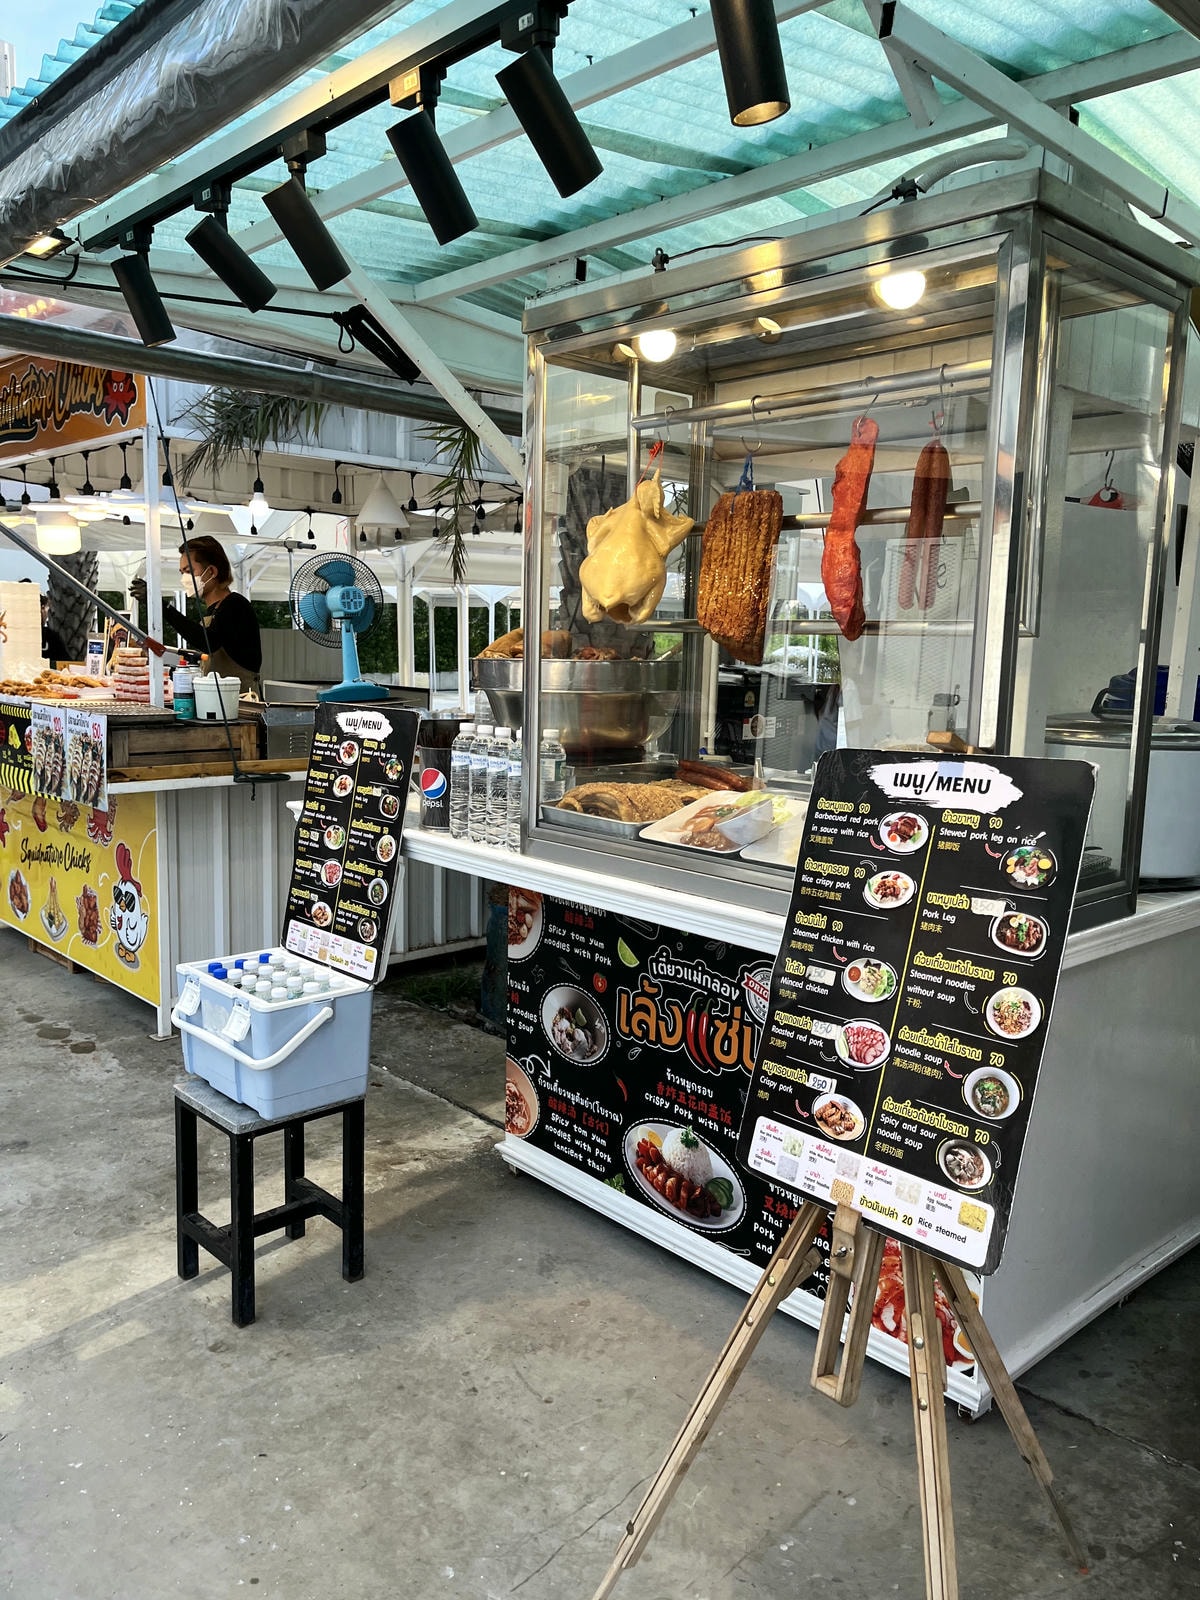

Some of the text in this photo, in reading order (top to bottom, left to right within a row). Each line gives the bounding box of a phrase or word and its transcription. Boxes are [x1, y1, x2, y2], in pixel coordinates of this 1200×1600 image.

[422, 799, 444, 808] pepsi
[859, 804, 870, 814] 90
[850, 816, 861, 824] red
[863, 818, 879, 826] pork
[989, 816, 1003, 829] 90
[820, 825, 838, 834] sauce
[840, 828, 855, 836] with
[857, 830, 870, 838] rice
[940, 828, 1037, 846] Stewed pork leg on rice
[20, 837, 91, 874] Squidnature Chicks
[801, 874, 851, 890] Rice crispy pork
[854, 868, 866, 878] 90
[922, 908, 956, 924] Pork Leg
[832, 920, 844, 932] 90
[544, 938, 570, 952] noodles
[574, 947, 592, 960] with
[570, 932, 586, 943] tom
[589, 938, 605, 950] yum
[792, 928, 876, 953] Steamed chicken with rice
[780, 976, 829, 996] Minced chicken
[910, 969, 976, 992] Steamed noodles
[1002, 971, 1018, 986] 70
[907, 984, 956, 1004] without soup
[512, 1008, 538, 1023] noodles
[772, 1025, 824, 1048] Roasted red pork
[894, 1044, 943, 1066] Noodle soup
[990, 1052, 1004, 1067] 70
[665, 1068, 714, 1098] ข้าวหมูกรอบ
[760, 1076, 793, 1094] Crispy pork
[573, 1123, 588, 1138] tom
[591, 1132, 607, 1148] yum
[698, 1116, 719, 1132] with
[724, 1126, 740, 1141] rice
[880, 1114, 938, 1140] Spicy and sour
[544, 1124, 572, 1143] noodles
[574, 1138, 592, 1153] with
[876, 1127, 923, 1150] noodle soup
[974, 1128, 990, 1145] 70
[762, 1210, 784, 1228] Thai
[902, 1214, 914, 1226] 20
[918, 1217, 933, 1230] Rice
[935, 1224, 968, 1244] steamed
[756, 1242, 773, 1255] and
